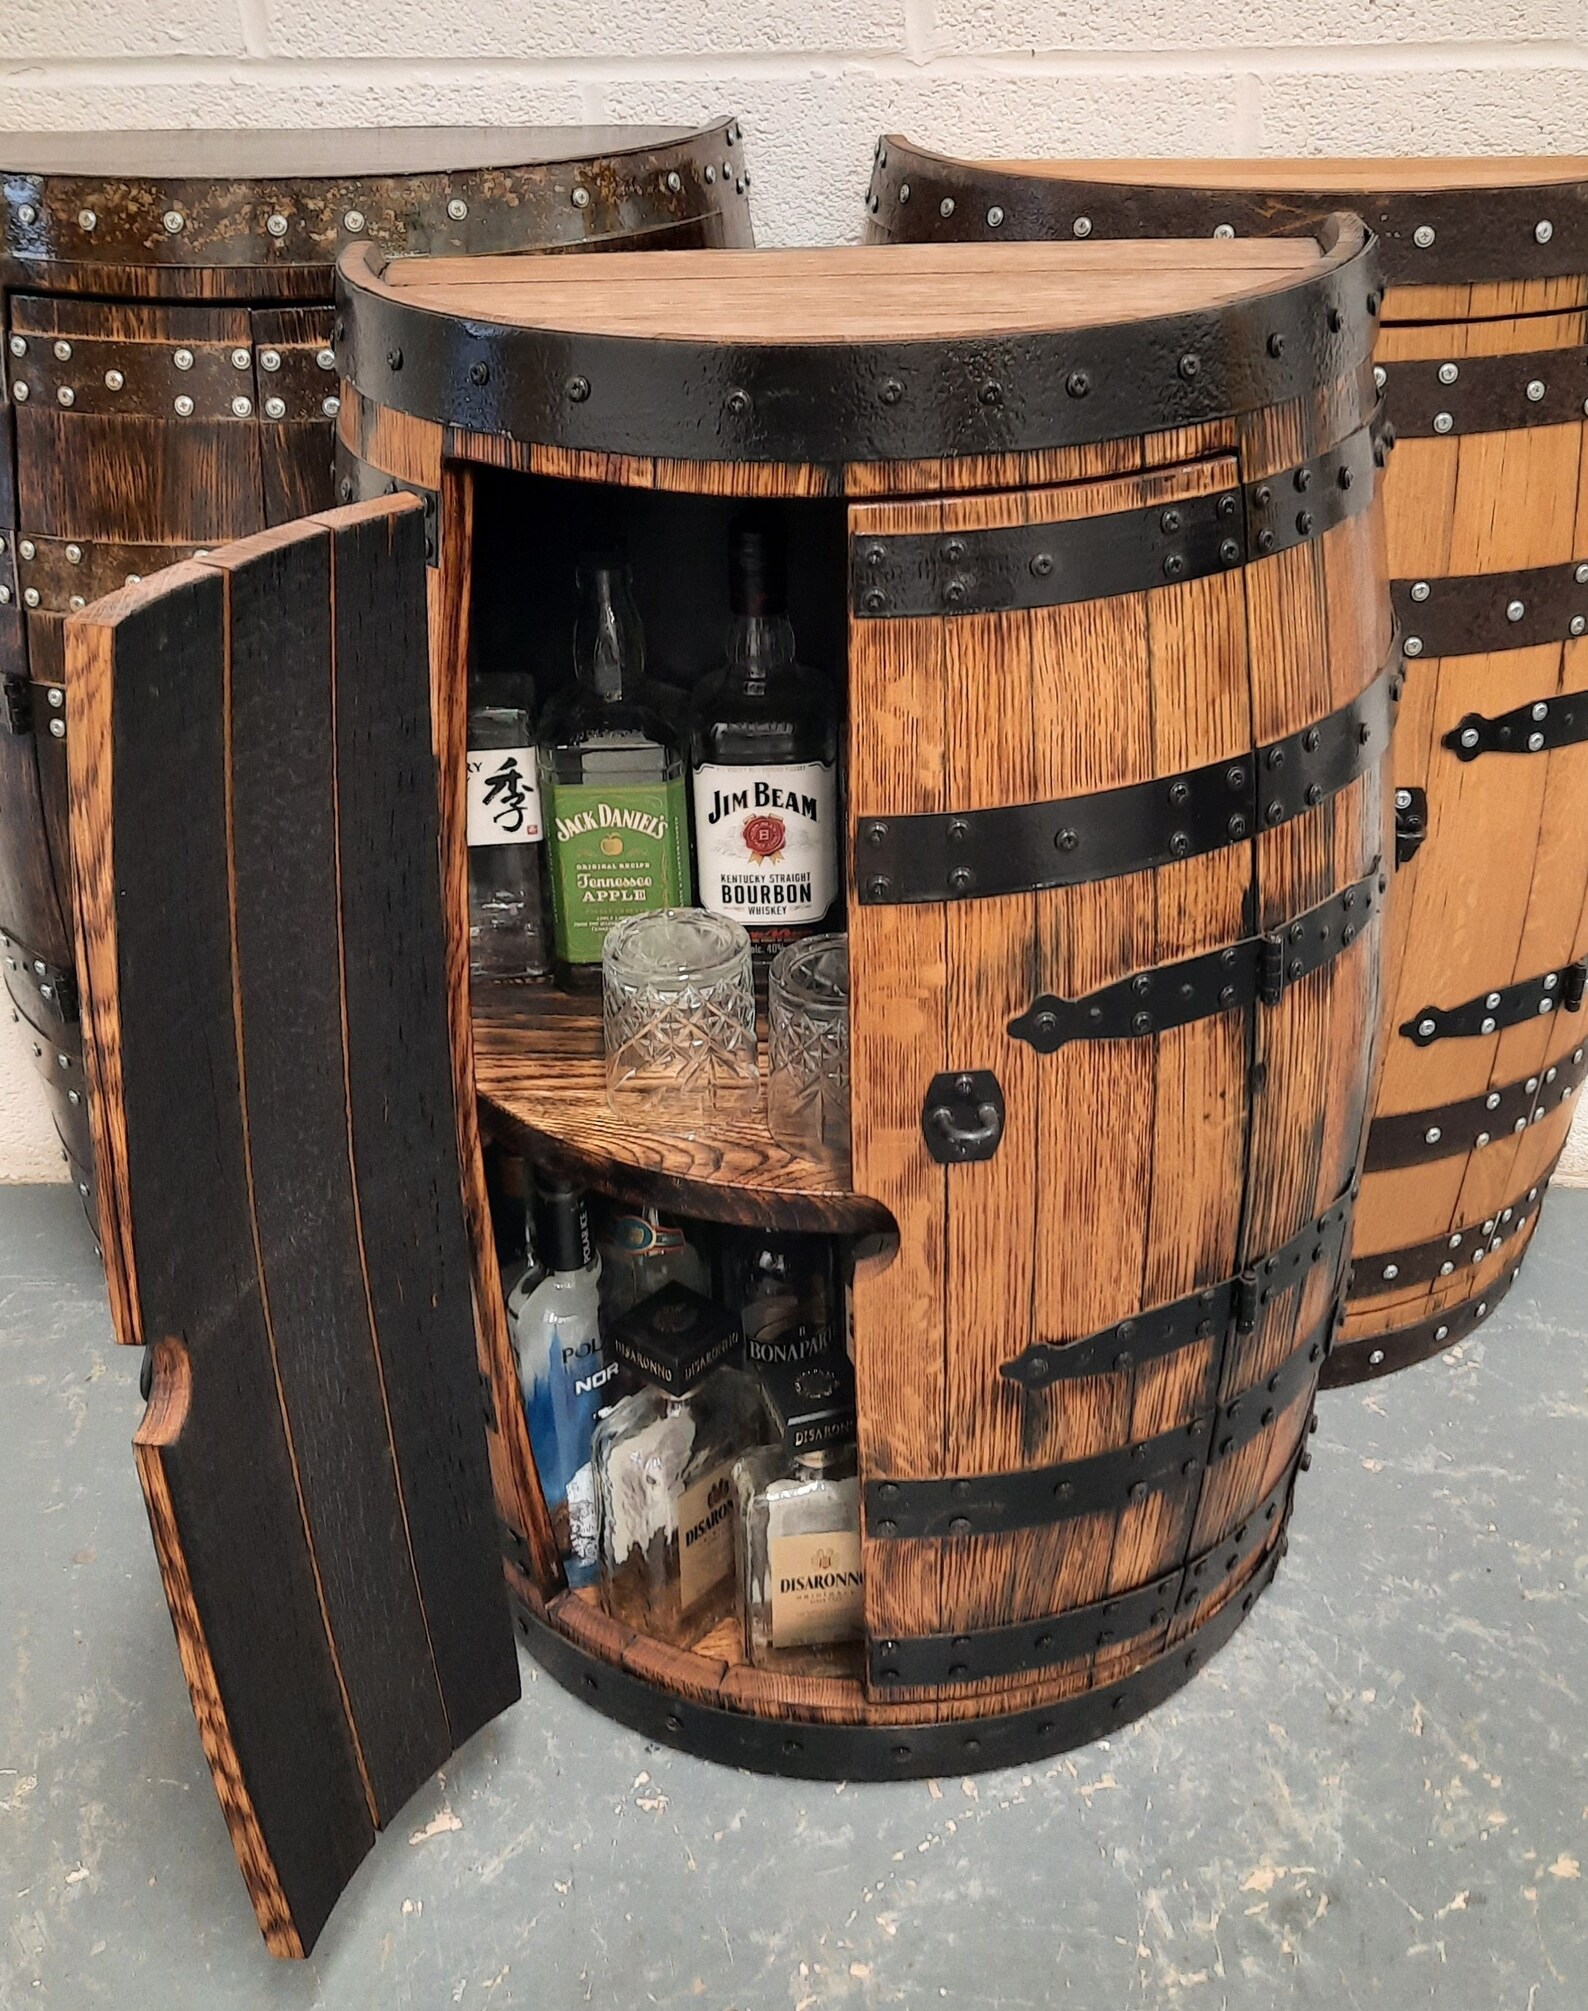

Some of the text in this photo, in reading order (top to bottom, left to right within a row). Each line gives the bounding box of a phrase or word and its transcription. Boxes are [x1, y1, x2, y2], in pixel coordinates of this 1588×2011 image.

[708, 781, 818, 824] JIM BEAM
[555, 803, 668, 842] JACK DANIEL'S
[576, 863, 617, 872] ORIGINAL
[576, 873, 653, 890] Tennessee
[720, 871, 811, 884] KENTUCKY STRAIGHT
[582, 889, 647, 903] APPLE
[721, 883, 812, 905] BOURBON
[748, 905, 787, 916] WHISKEY
